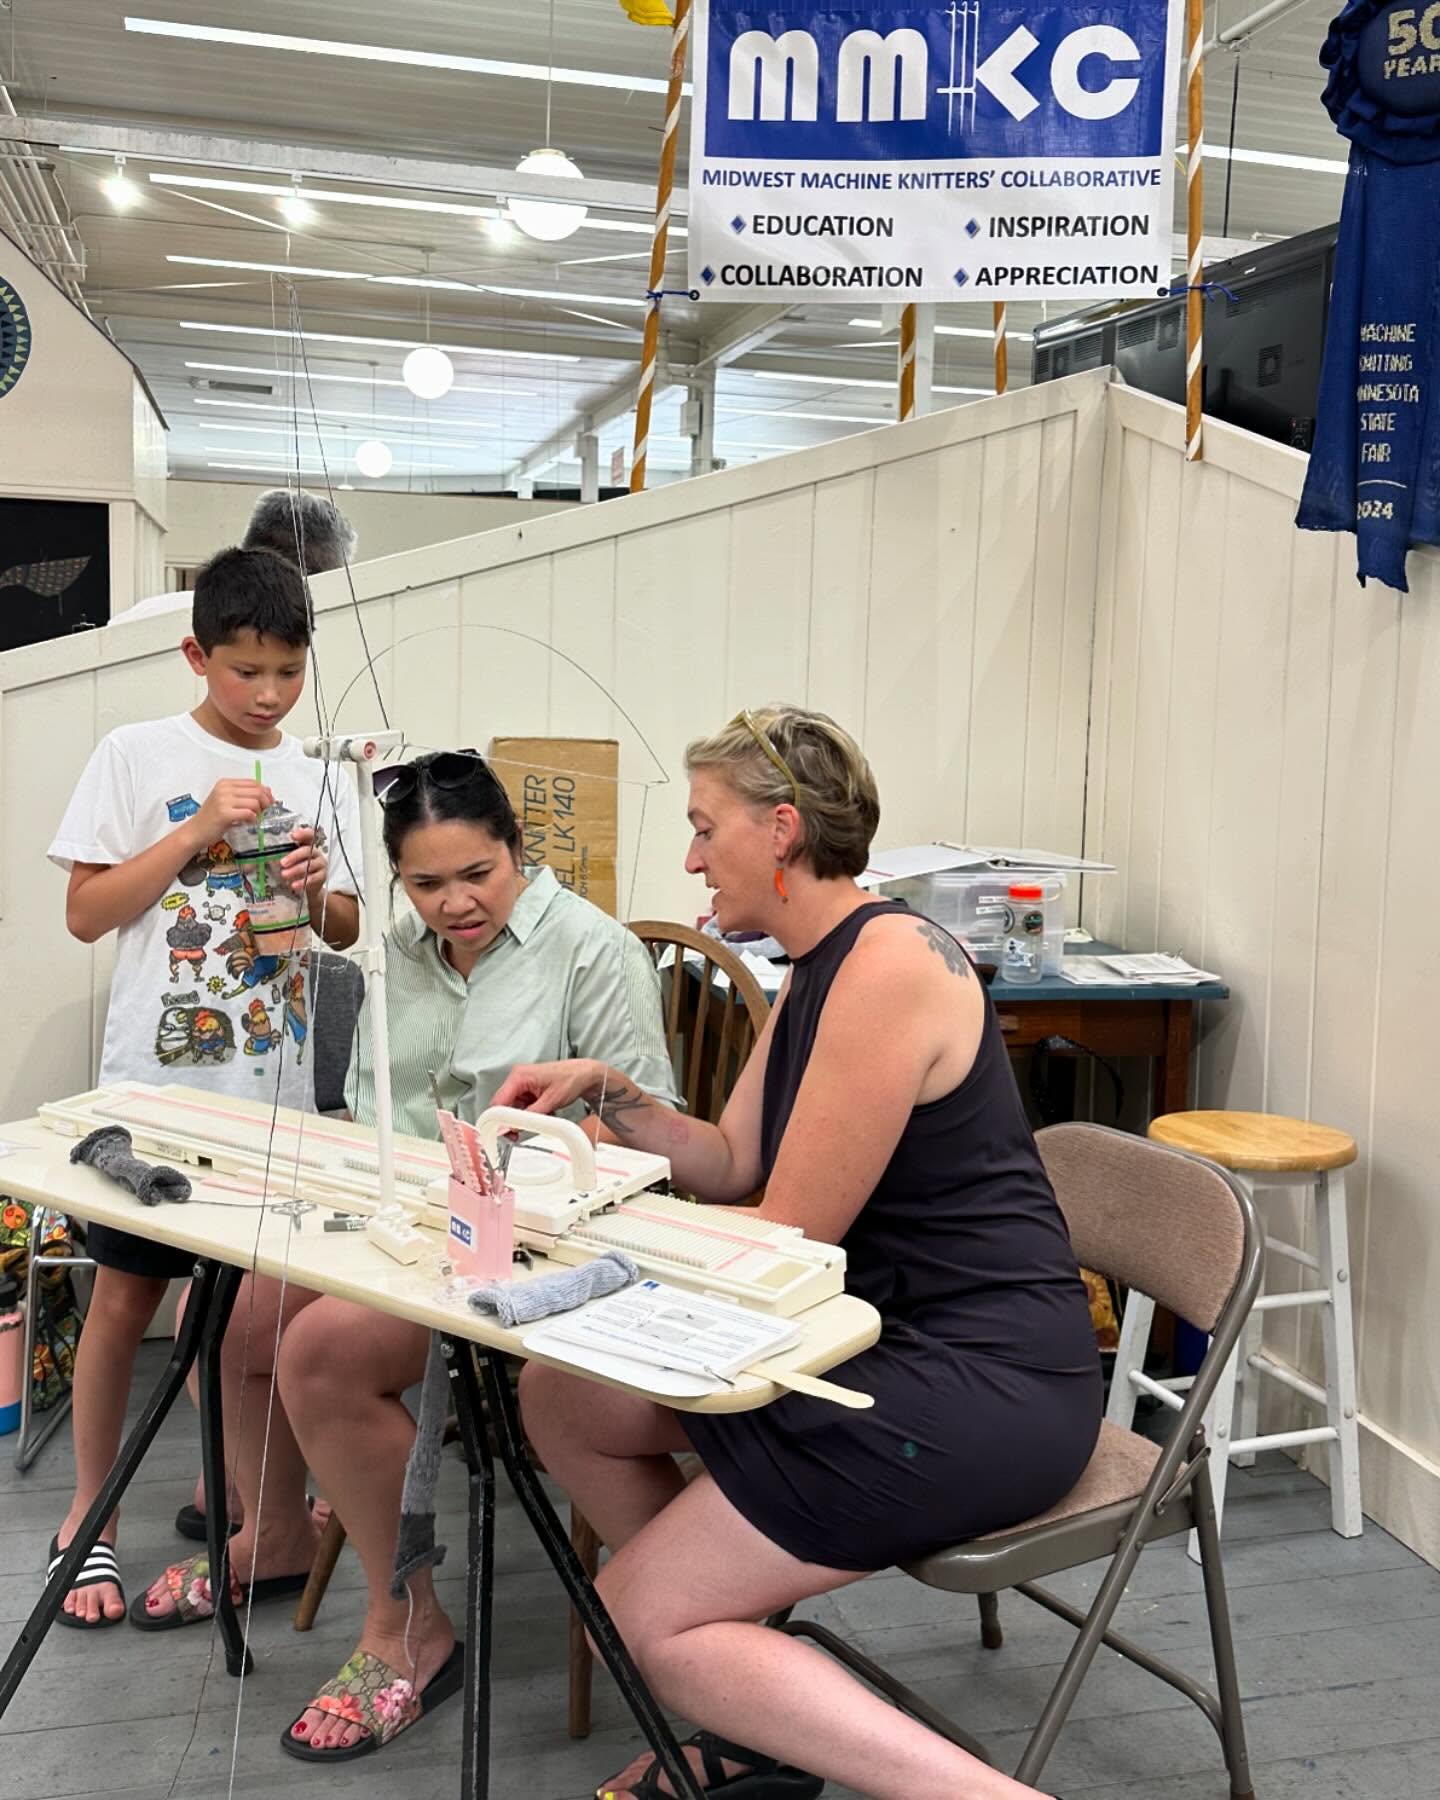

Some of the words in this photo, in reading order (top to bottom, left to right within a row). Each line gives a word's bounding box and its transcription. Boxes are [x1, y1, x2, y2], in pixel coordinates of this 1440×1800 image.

[702, 169, 795, 188] MIDWEST
[800, 172, 892, 190] MACHINE
[1001, 168, 1161, 188] COLLABORATIVE
[752, 214, 894, 238] EDUCATION
[989, 214, 1149, 238] INSPIRATION
[720, 264, 923, 288] COLLABORATION
[975, 265, 1159, 287] APPRECIATION
[1361, 412, 1397, 431] STATE
[1361, 442, 1392, 463] FAIR
[552, 776, 576, 820] 140
[523, 774, 547, 867] KNITTER
[553, 825, 576, 852] LK
